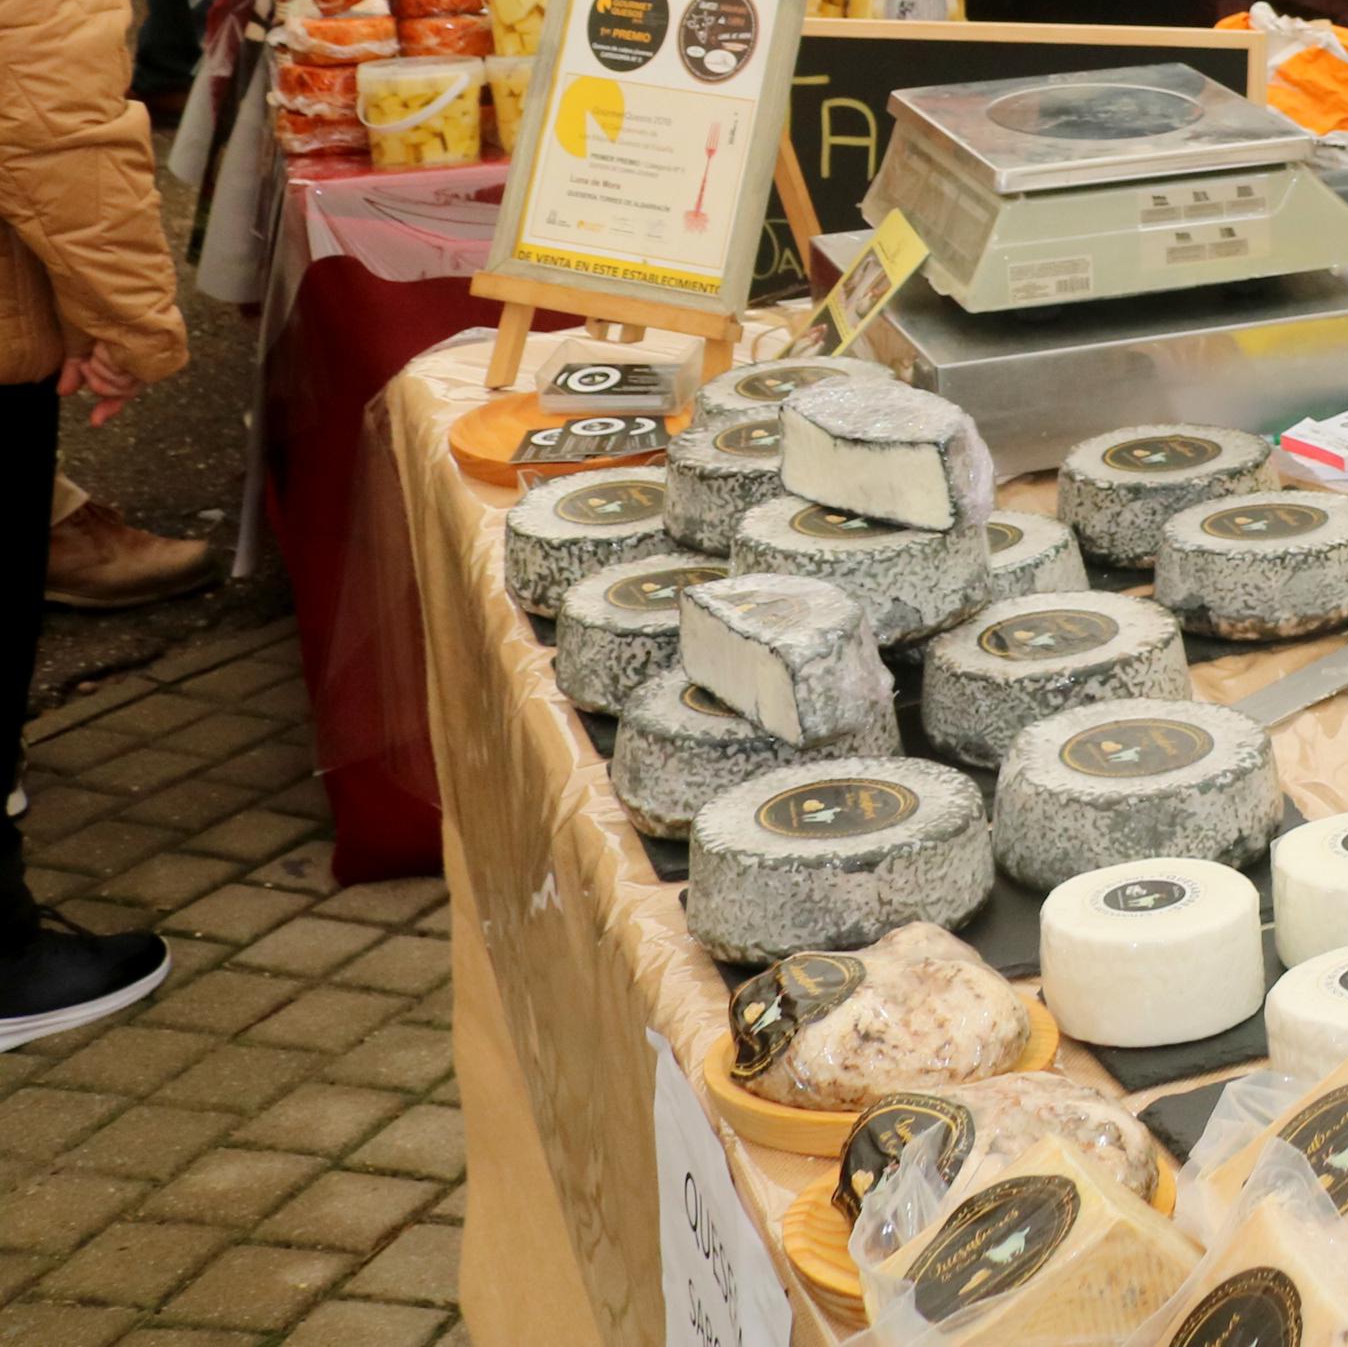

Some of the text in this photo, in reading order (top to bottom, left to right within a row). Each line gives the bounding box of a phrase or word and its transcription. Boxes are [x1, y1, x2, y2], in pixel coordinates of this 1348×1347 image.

[610, 7, 644, 19] QUESOS
[612, 28, 653, 44] PREMIO
[518, 250, 532, 261] DE
[535, 253, 572, 269] VENTA
[574, 260, 590, 272] EN
[592, 264, 620, 277] ESTE
